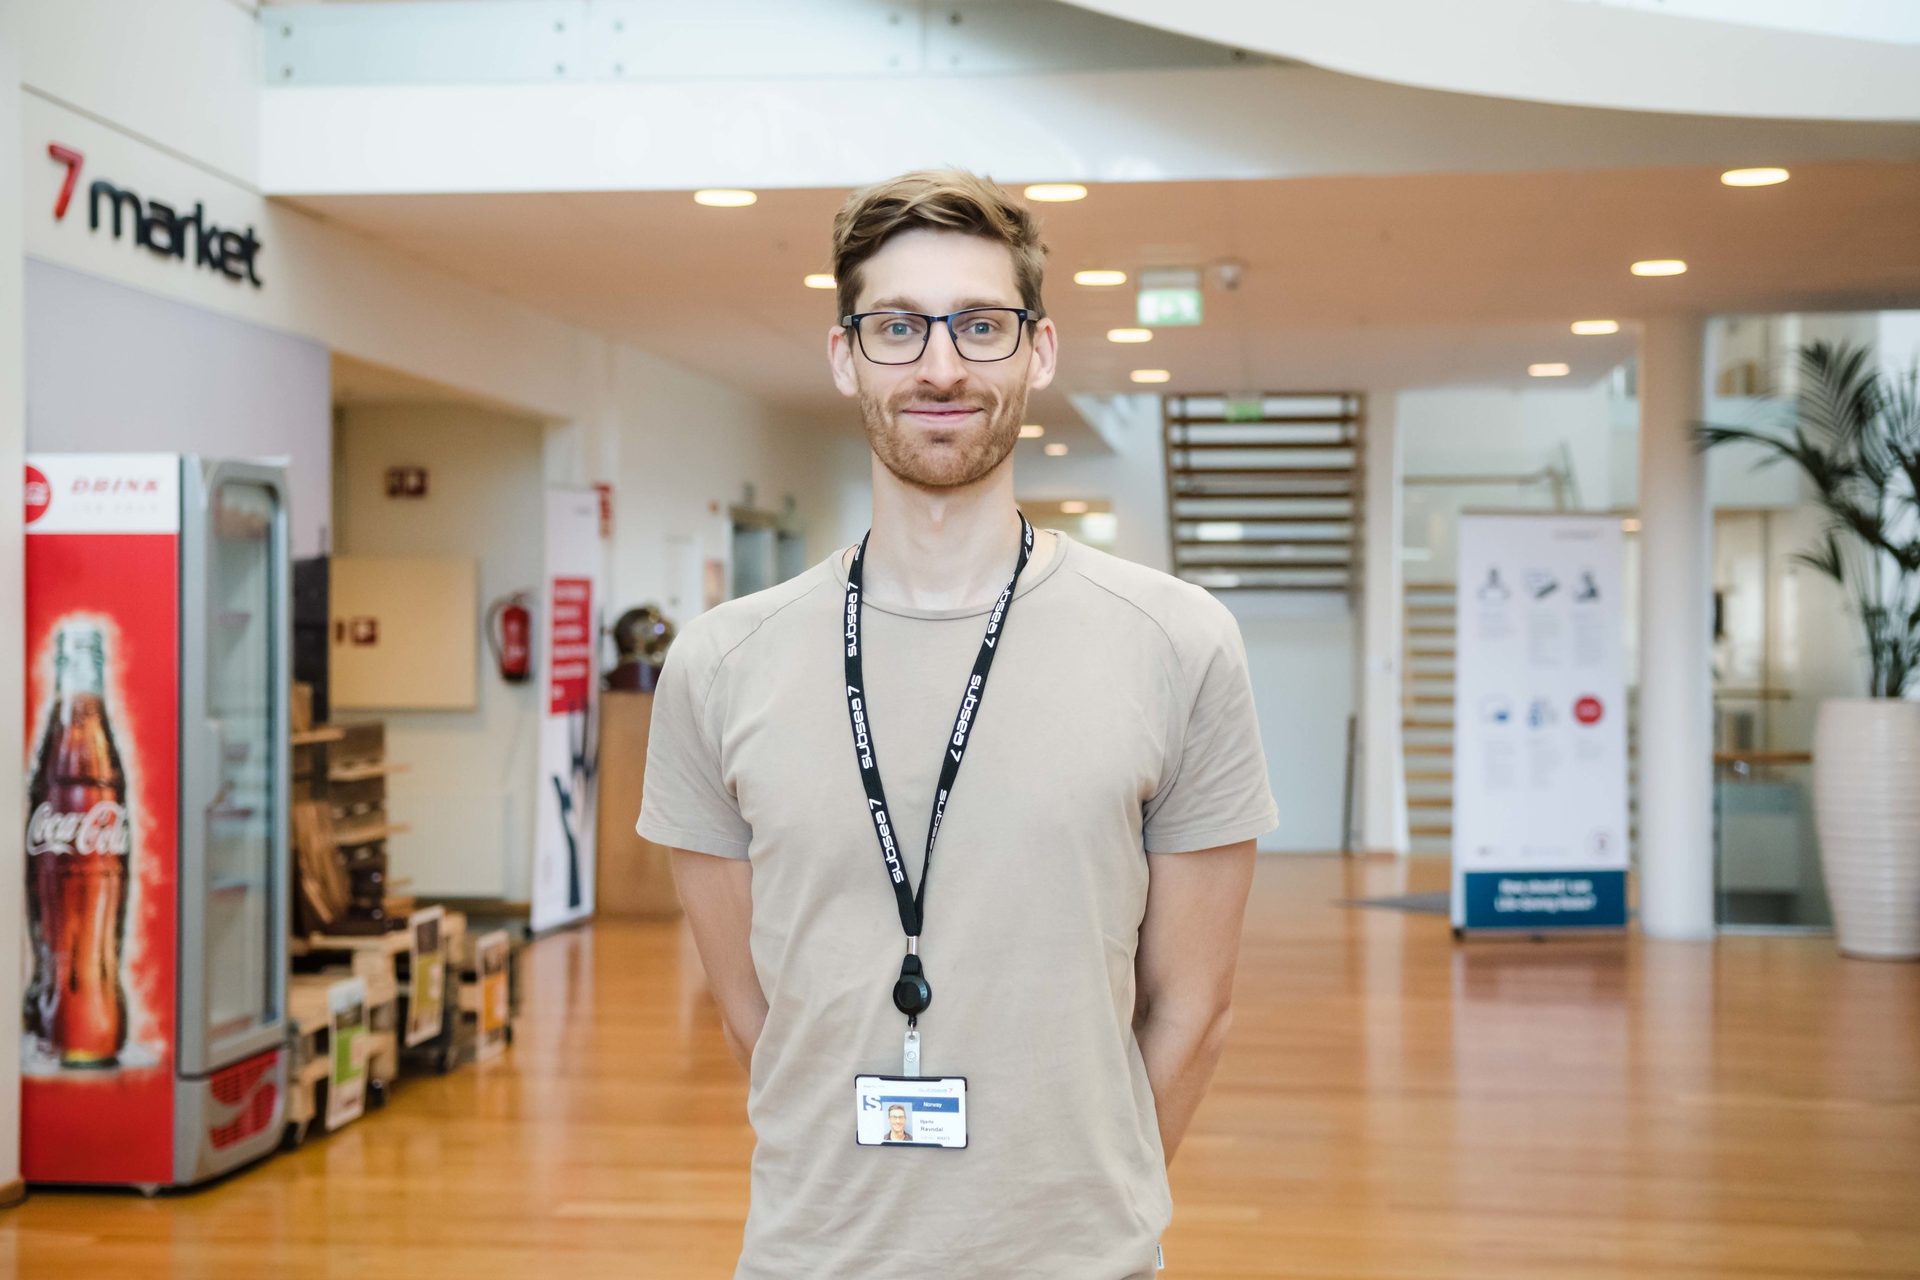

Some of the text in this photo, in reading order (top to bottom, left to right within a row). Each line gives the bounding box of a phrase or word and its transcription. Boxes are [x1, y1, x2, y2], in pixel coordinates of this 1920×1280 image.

[48, 143, 263, 288] 7 market
[851, 697, 874, 770] subsea
[954, 674, 982, 746] subsea
[876, 810, 905, 884] subsea
[923, 1101, 943, 1109] Norway
